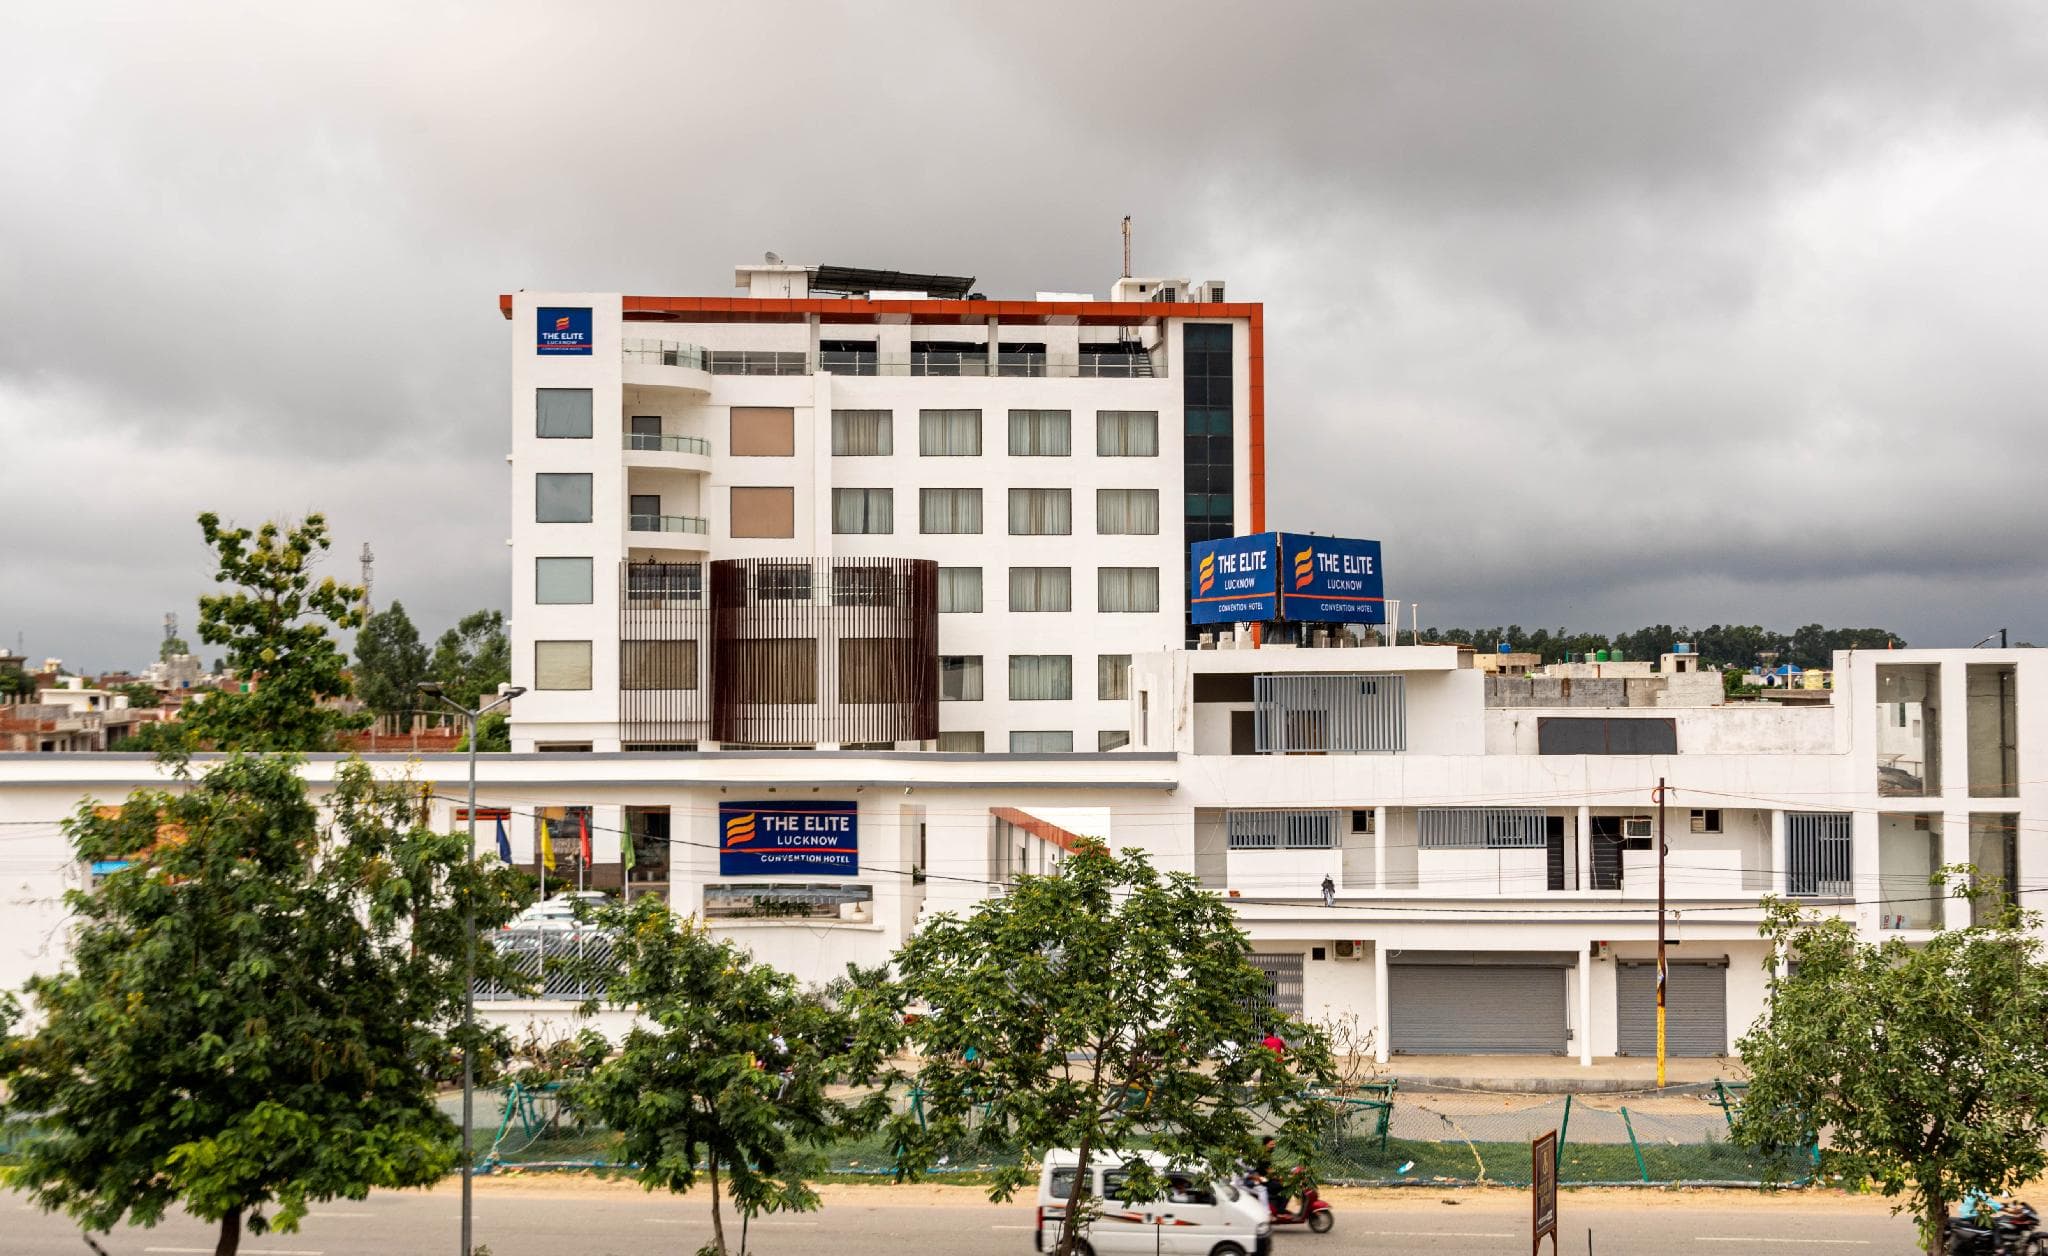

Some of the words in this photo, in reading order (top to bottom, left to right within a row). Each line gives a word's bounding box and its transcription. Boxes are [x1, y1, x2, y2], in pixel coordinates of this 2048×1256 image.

[1217, 554, 1236, 574] THE
[1240, 550, 1267, 572] ELITE
[1317, 553, 1340, 573] THE
[1343, 554, 1373, 575] ELITE
[1224, 577, 1255, 590] LUCKNOW
[1327, 579, 1362, 591] LUCKNOW
[1218, 603, 1247, 613] CONVENTION
[1248, 602, 1263, 611] HOTEL
[1320, 603, 1355, 612] CONVENTION
[1356, 605, 1373, 613] HOTEL
[762, 816, 799, 831] THE
[804, 816, 850, 831] ELITE
[777, 836, 838, 845] LUCKNOW
[760, 855, 822, 863] CONVENTION
[823, 855, 850, 863] HOTEL
